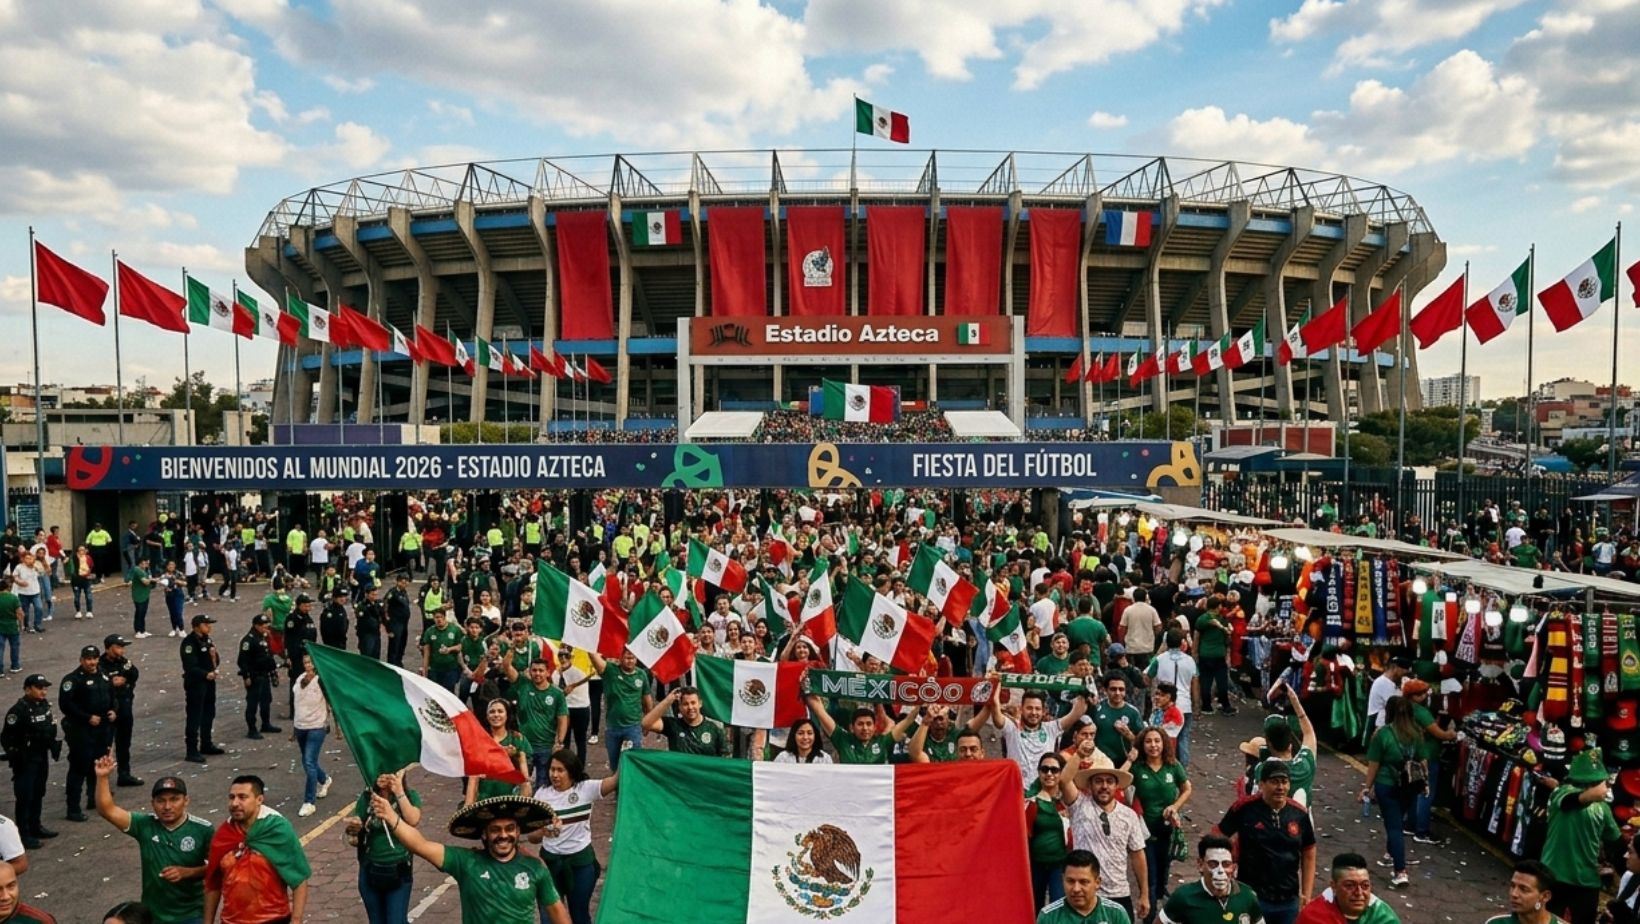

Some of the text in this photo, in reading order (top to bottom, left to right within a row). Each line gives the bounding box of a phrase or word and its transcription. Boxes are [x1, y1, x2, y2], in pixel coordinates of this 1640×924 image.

[765, 324, 939, 343] Estadio Azteca
[161, 456, 279, 480] BIENVENIDOS
[283, 456, 306, 479] AL
[310, 456, 391, 479] MUNDIAL
[396, 455, 442, 479] 2026
[457, 455, 532, 479] ESTADIO
[537, 455, 606, 478] AZTECA
[912, 448, 1097, 478] FIESTA DEL FÚTBOL
